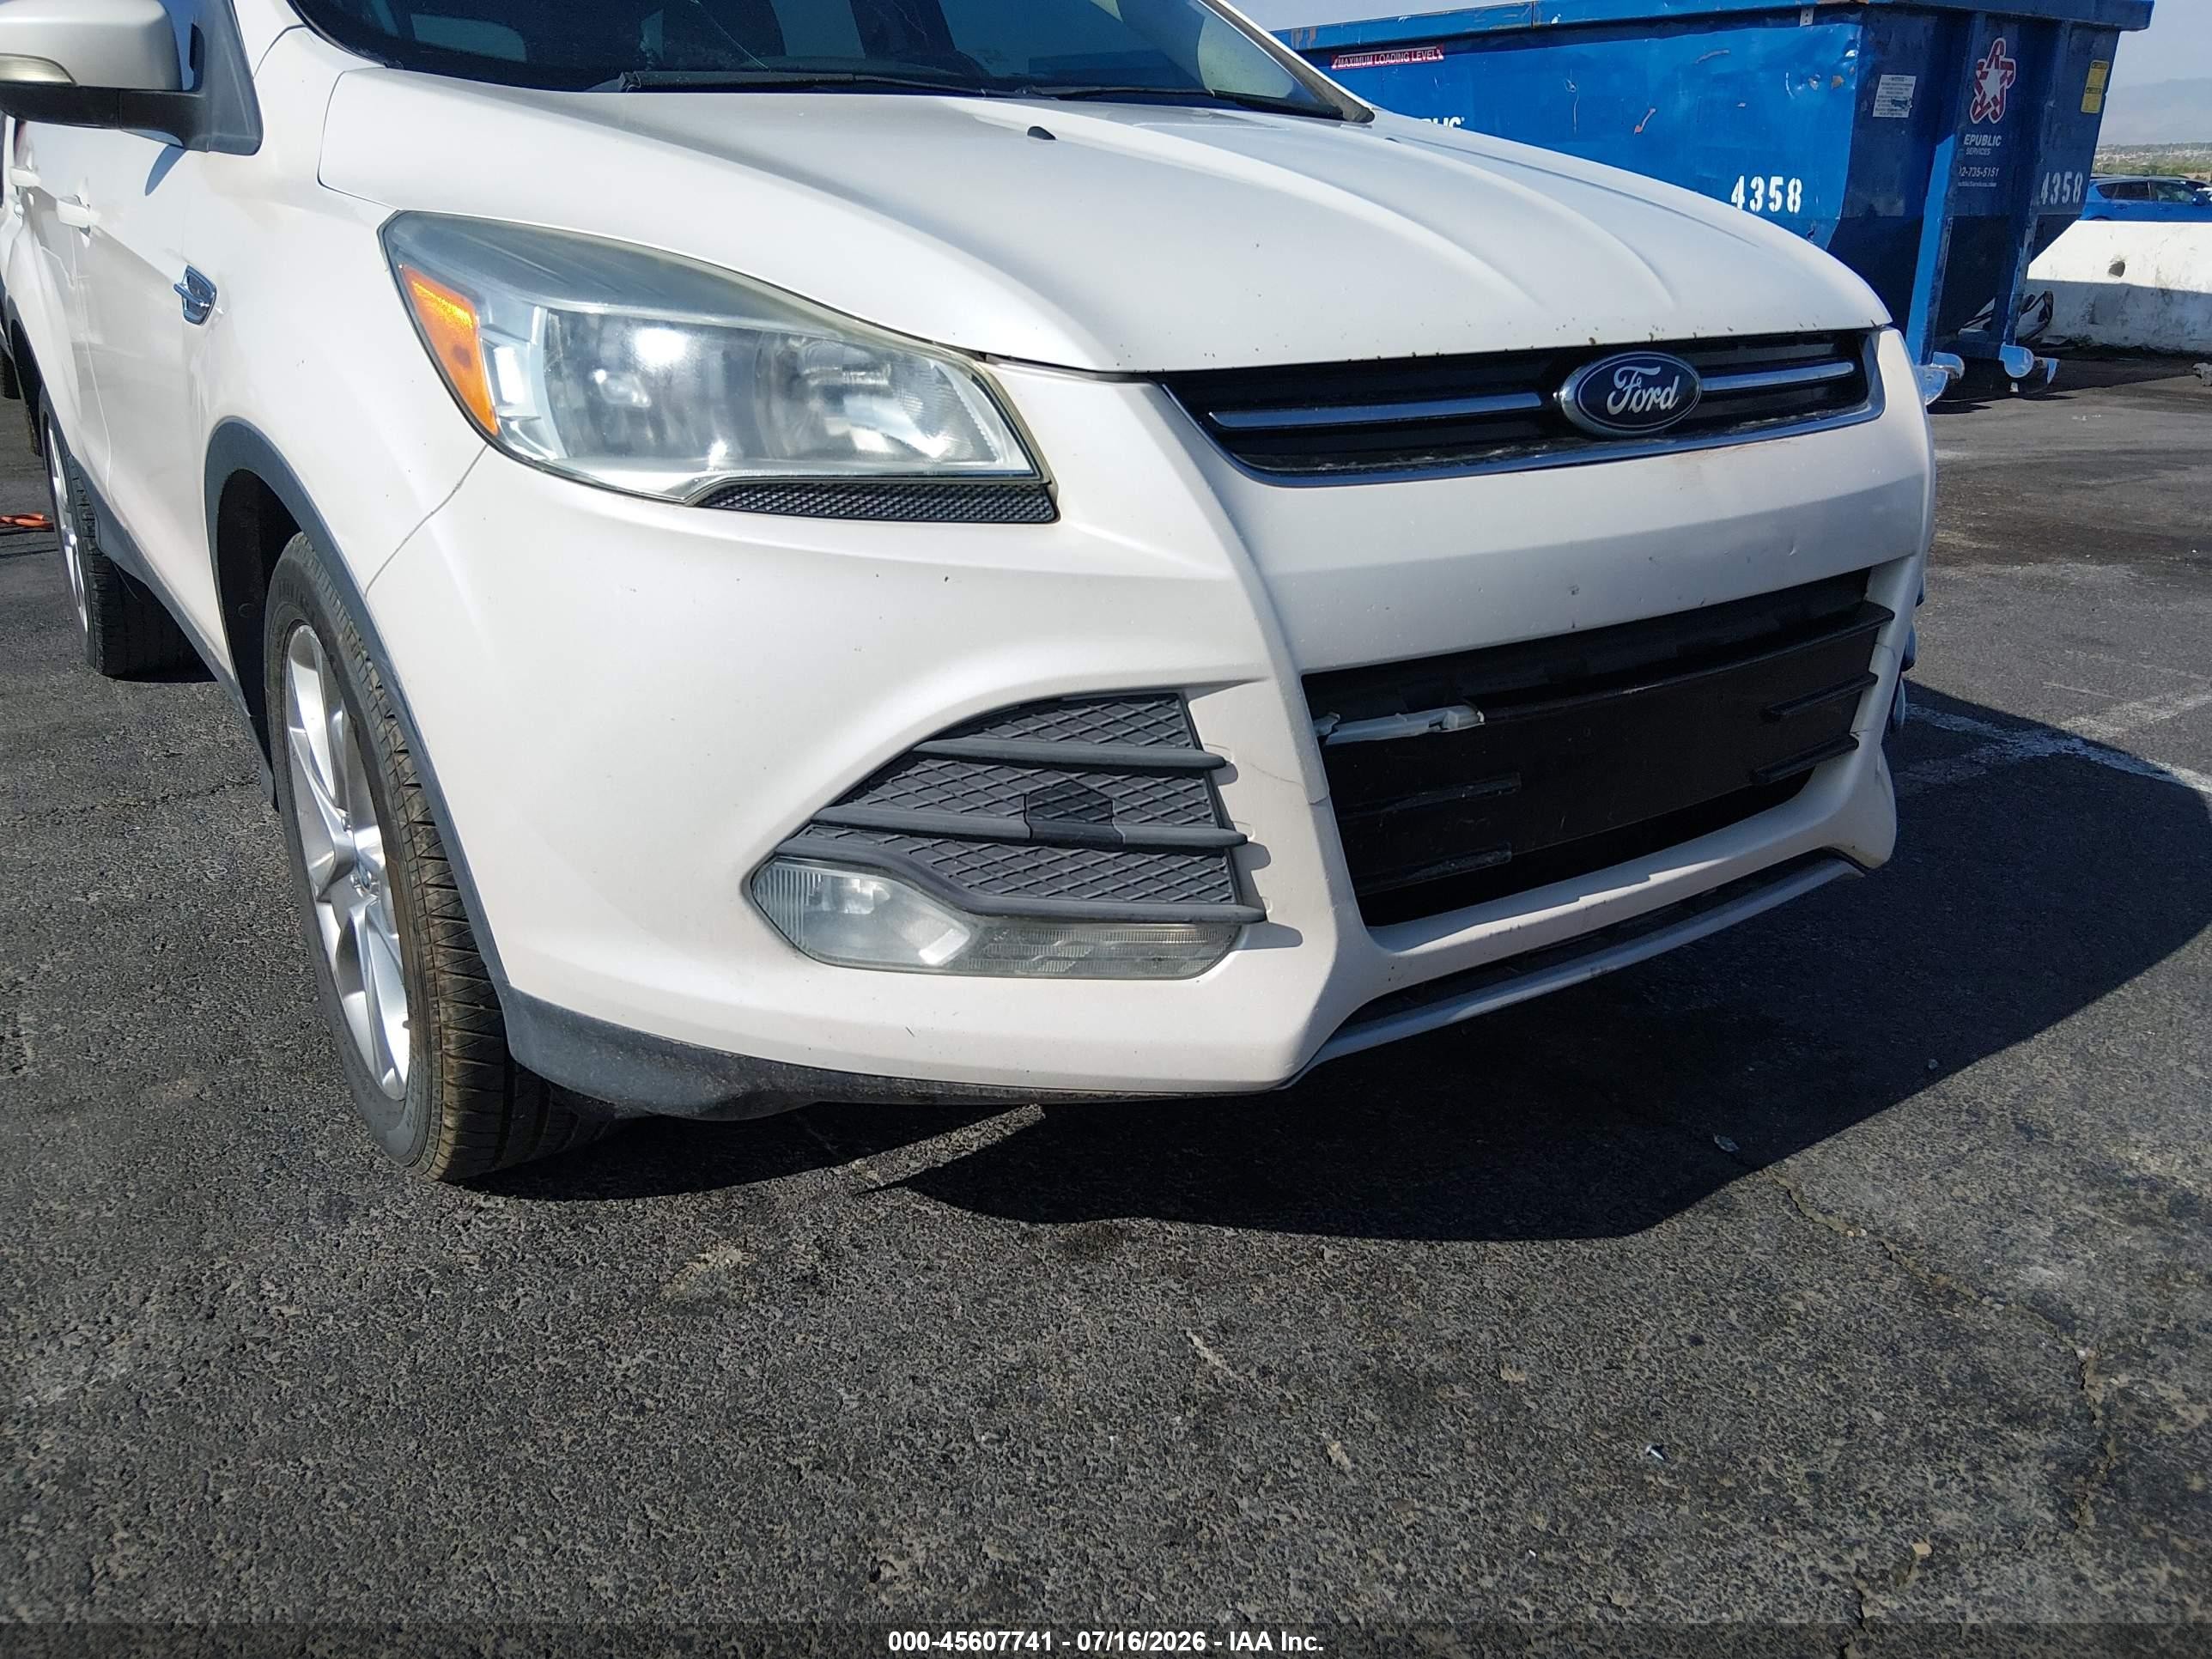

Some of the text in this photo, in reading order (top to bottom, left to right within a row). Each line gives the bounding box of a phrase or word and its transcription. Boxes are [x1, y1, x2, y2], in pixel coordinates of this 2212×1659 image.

[1338, 49, 1437, 68] MAXIMUM LOADING LEVEL
[1966, 147, 1991, 155] SERVICES
[1730, 175, 1802, 213] 4358
[2040, 171, 2083, 205] 4358
[1606, 365, 1680, 416] Ford
